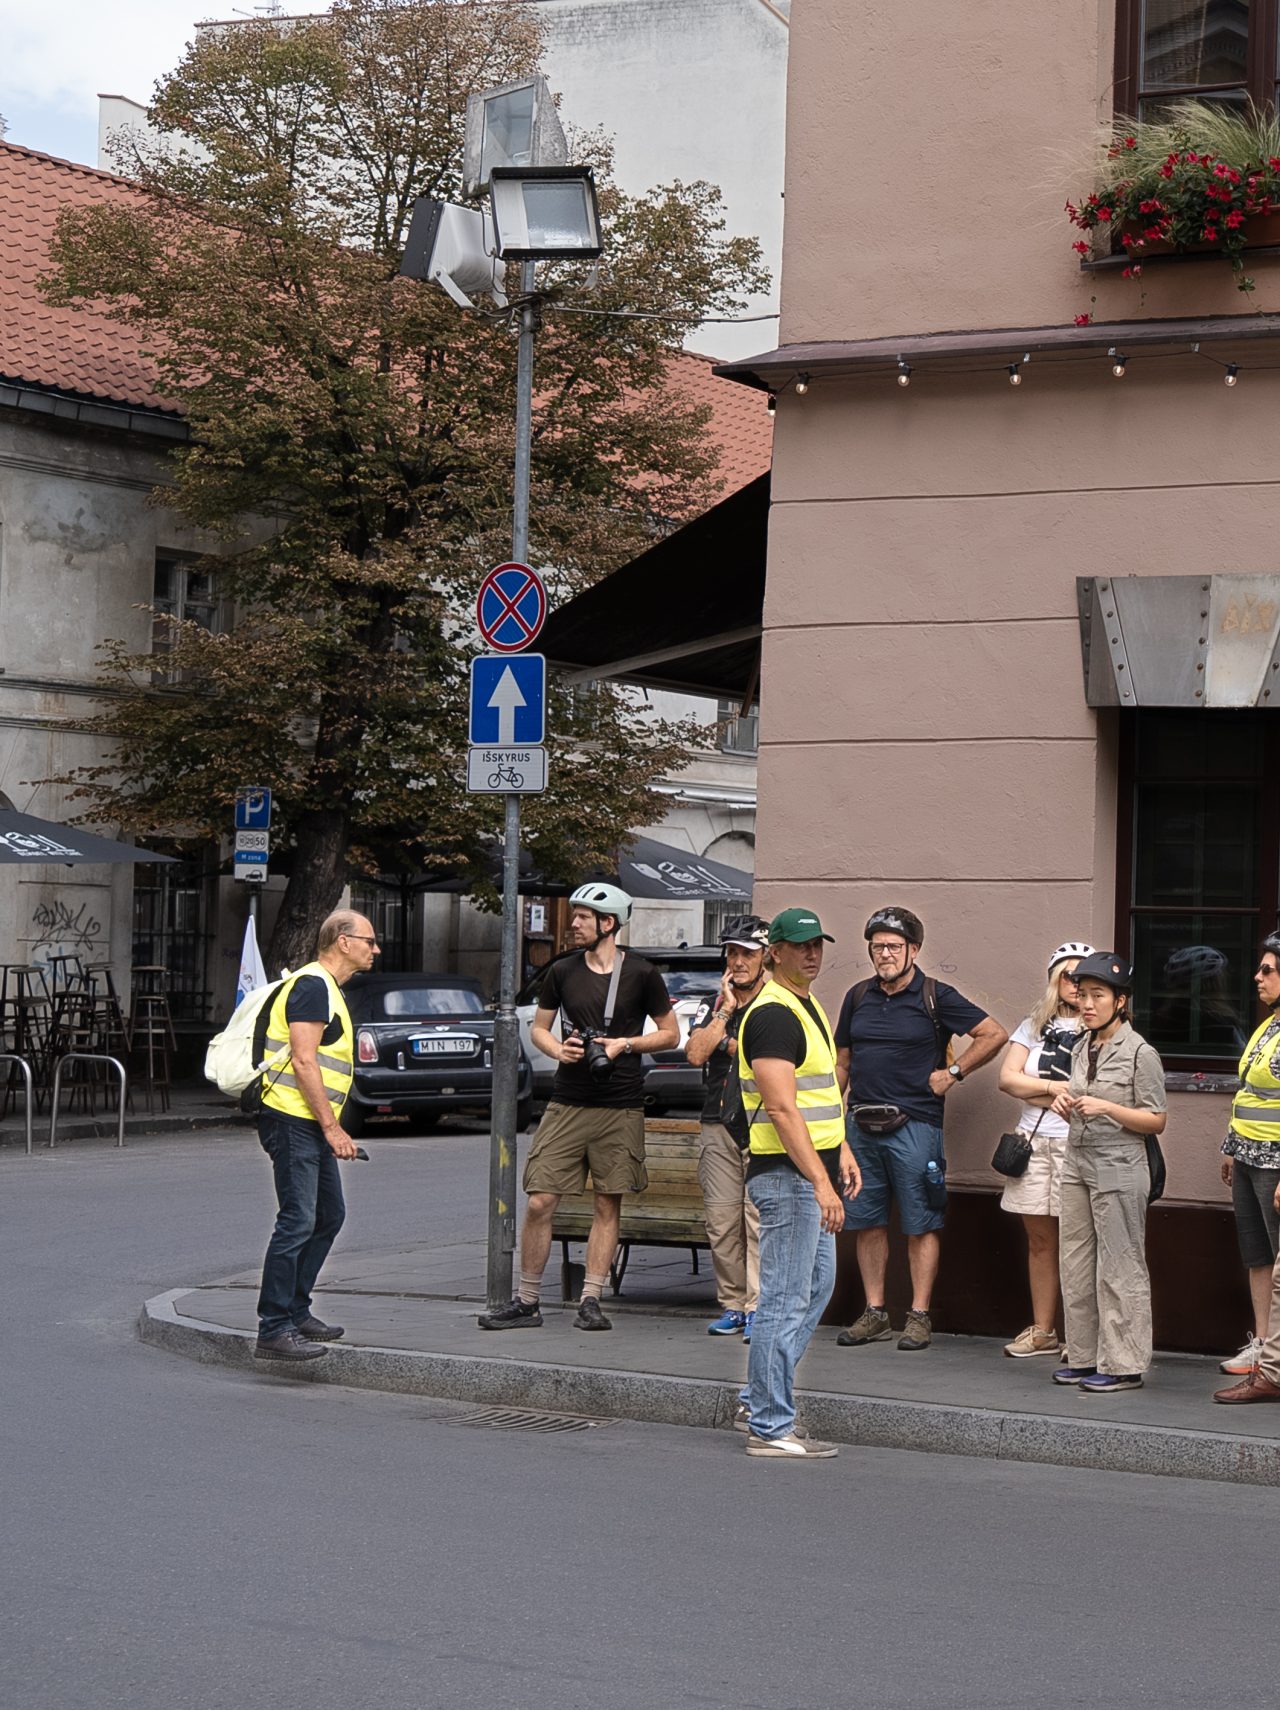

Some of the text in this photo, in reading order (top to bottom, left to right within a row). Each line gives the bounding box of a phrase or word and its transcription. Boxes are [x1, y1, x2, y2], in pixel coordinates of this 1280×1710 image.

[482, 751, 530, 762] IŠSKYRUS
[245, 793, 264, 824] P
[246, 837, 254, 845] 20
[255, 837, 265, 846] 50
[421, 1041, 445, 1051] MIN
[453, 1040, 471, 1050] 197
